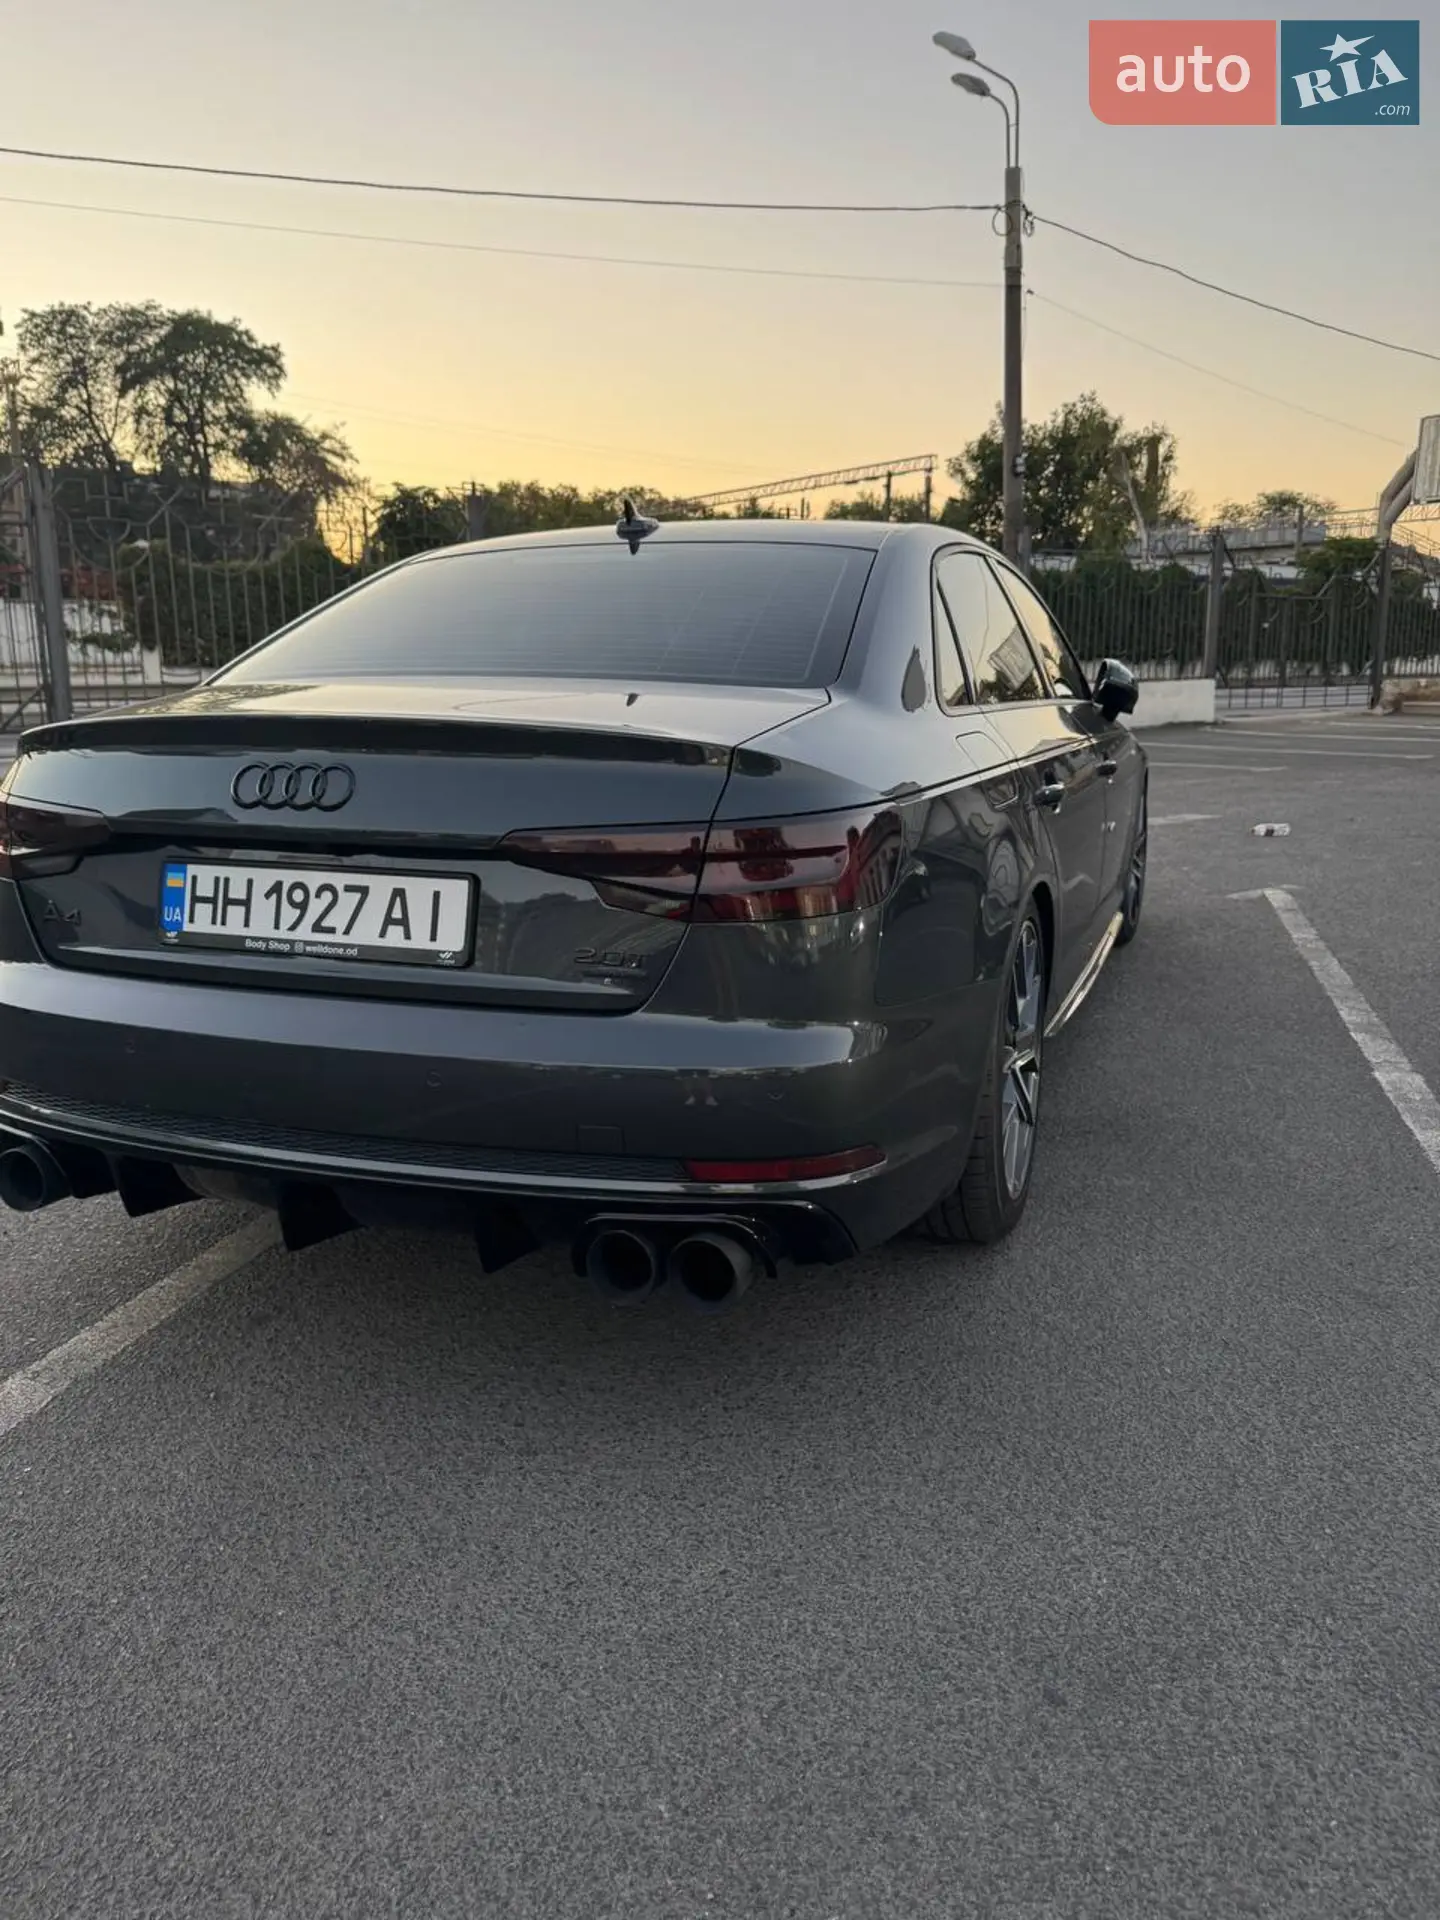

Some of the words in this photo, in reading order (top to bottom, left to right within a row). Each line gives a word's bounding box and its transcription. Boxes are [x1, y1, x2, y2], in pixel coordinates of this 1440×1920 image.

[164, 906, 182, 922] UA
[188, 874, 254, 928] HH
[263, 880, 370, 935] 1927
[378, 887, 441, 942] AI
[245, 938, 266, 951] Body
[268, 939, 291, 953] Shop
